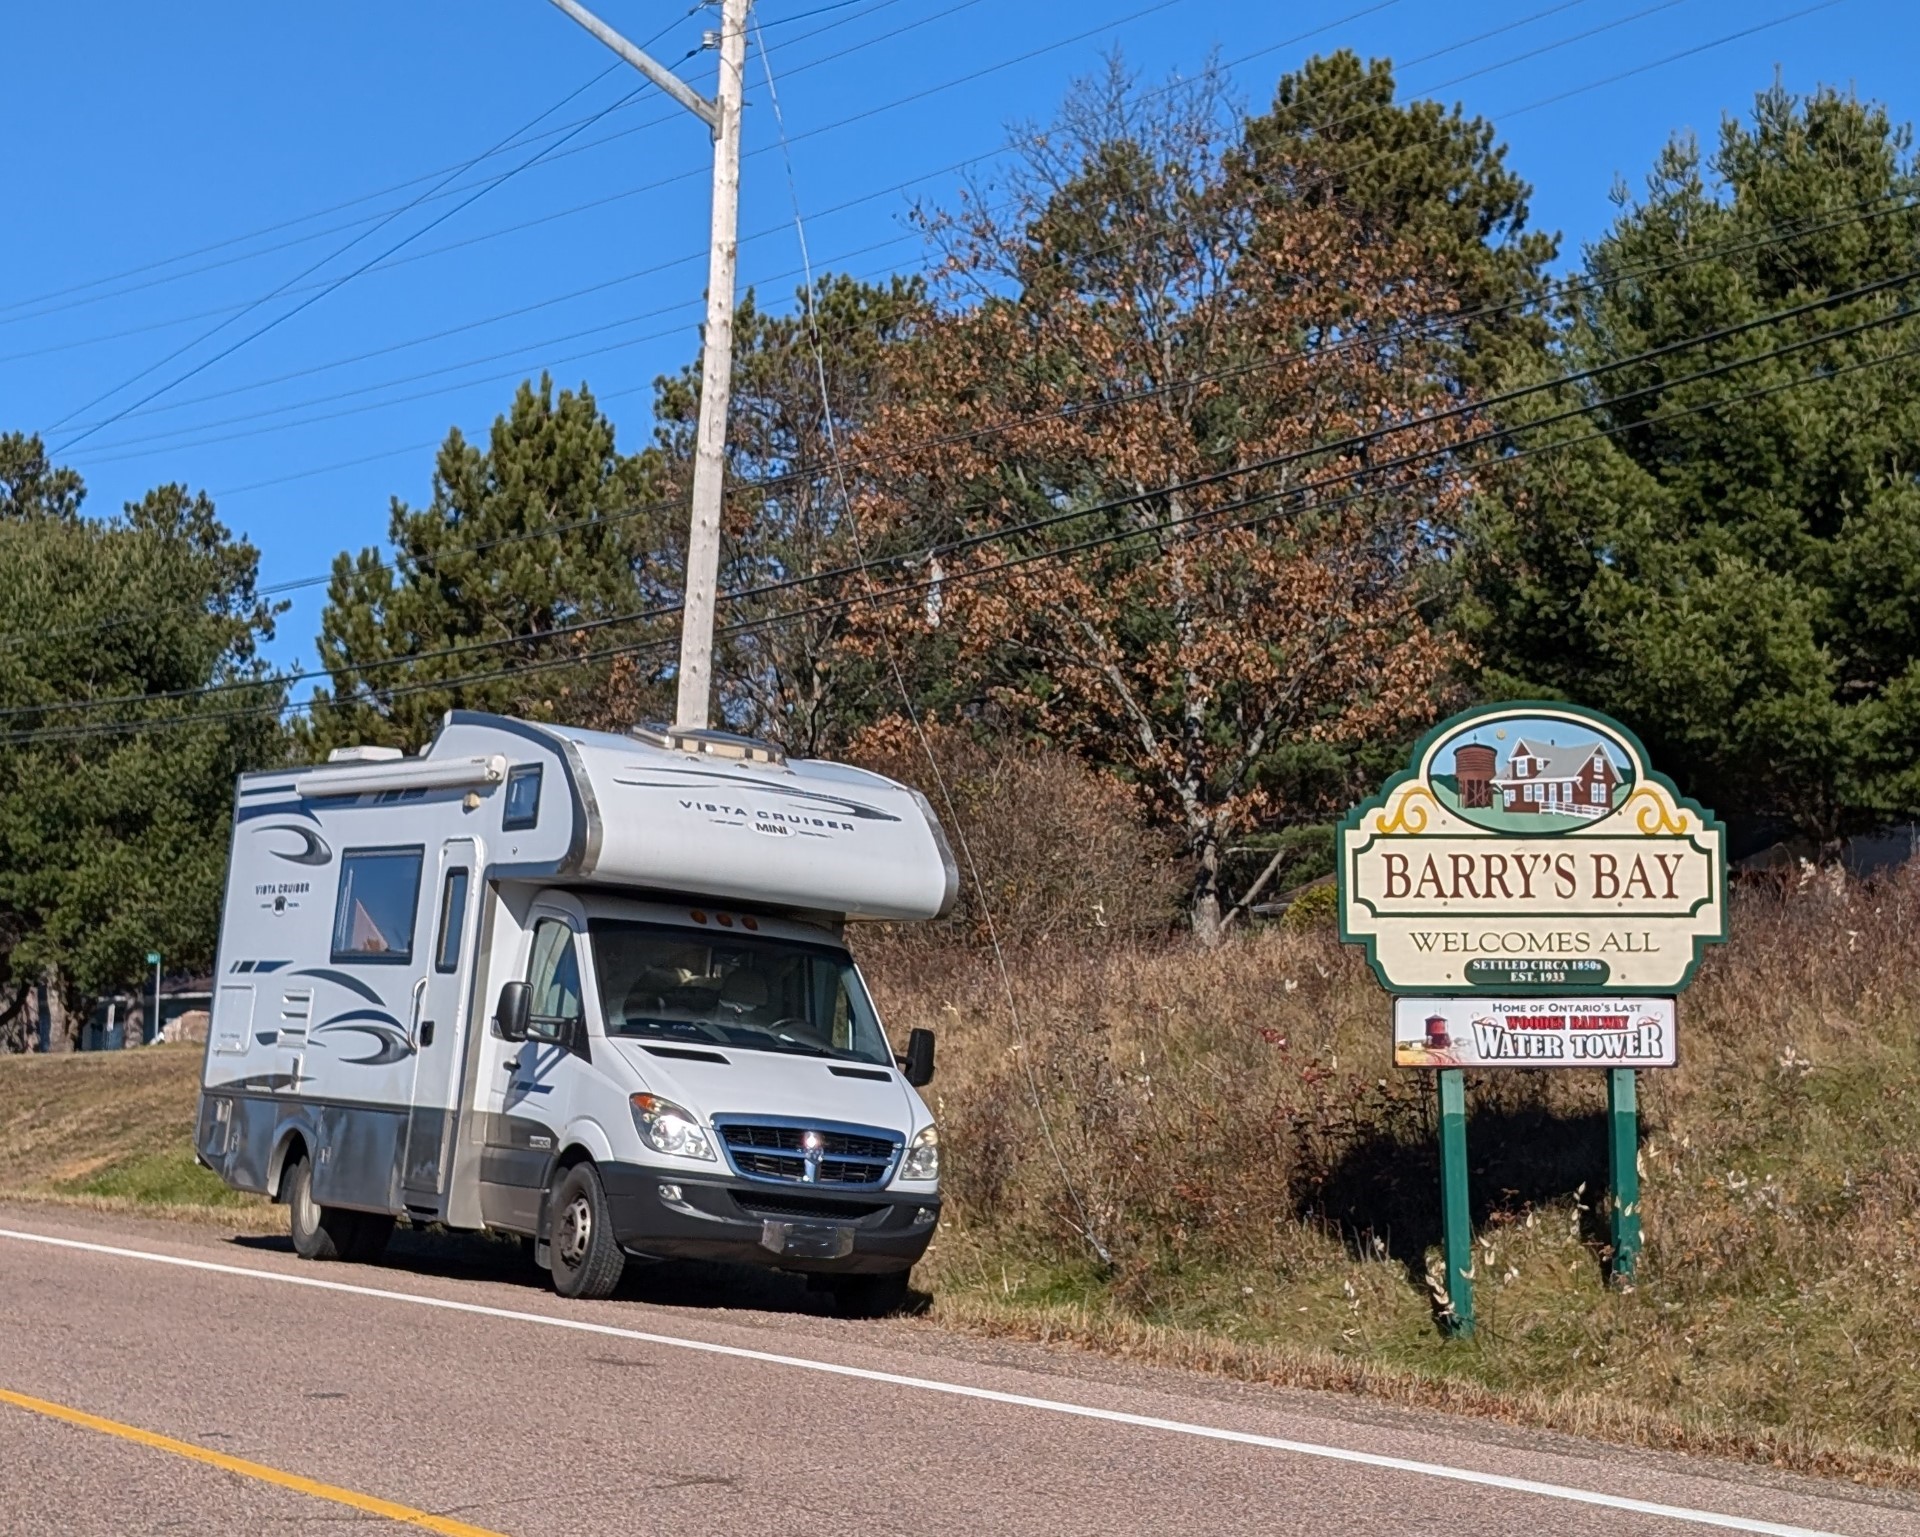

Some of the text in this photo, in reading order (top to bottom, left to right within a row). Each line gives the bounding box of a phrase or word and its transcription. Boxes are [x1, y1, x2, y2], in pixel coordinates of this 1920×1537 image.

[679, 800, 855, 831] VISTA CRUISER
[756, 822, 788, 835] MINI
[1381, 852, 1684, 899] BARRY'S BAY
[1409, 932, 1660, 952] WELCOMES ALL
[1472, 960, 1528, 970] SETTLED
[1530, 960, 1569, 970] CIRCA
[1510, 972, 1565, 983] EST. 1933
[1505, 1016, 1630, 1030] WOODEN RAILWAY
[1472, 1020, 1663, 1059] WATER TOWER
